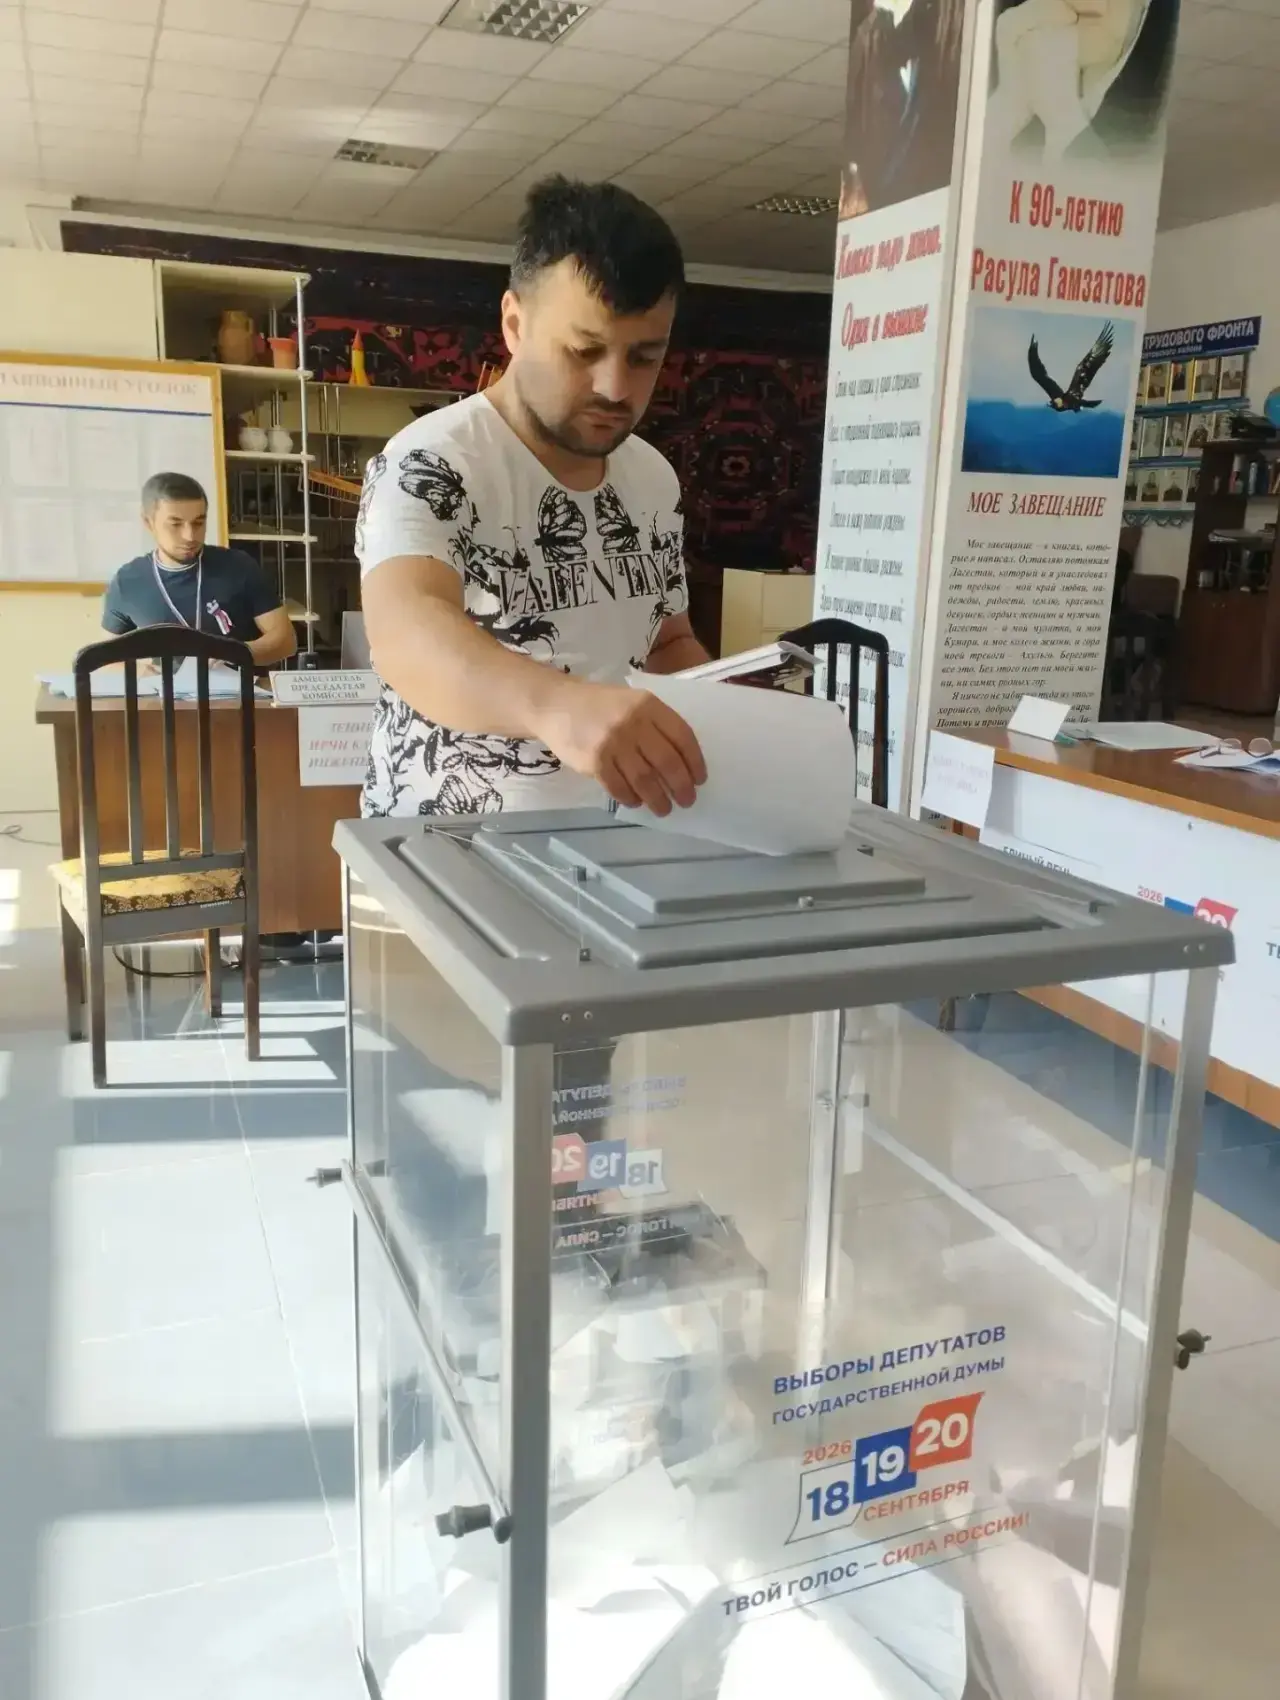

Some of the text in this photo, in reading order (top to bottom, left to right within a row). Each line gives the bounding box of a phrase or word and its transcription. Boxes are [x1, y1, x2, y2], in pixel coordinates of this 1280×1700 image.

[1009, 180, 1124, 236] К 90-летию
[971, 248, 1146, 308] Расула Гамзатова
[1144, 321, 1254, 350] ТРУДОВОГО ФРОНТА
[966, 492, 1107, 518] МОЕ ЗАВЕЩАНИЕ
[1060, 650, 1099, 662] Берегите
[291, 683, 366, 691] ПРЕДСЕДАТЕЛЯ
[960, 692, 989, 700] ничего
[936, 718, 973, 728] Потому
[1137, 885, 1163, 903] 2026
[773, 1325, 1006, 1395] ВЫБОРЫ ДЕПУТАТОВ
[772, 1356, 1005, 1425] ГОСУДАРСТВЕННОЙ ДУМЫ
[802, 1440, 852, 1467] 2026
[806, 1412, 968, 1522] 18 19 20
[863, 1479, 970, 1522] СЕНТЯБРЯ
[723, 1582, 782, 1616] ТВОЙ
[787, 1562, 858, 1596] ГОЛОС
[882, 1540, 938, 1567] СИЛА
[943, 1511, 1031, 1550] РОССИИ!
